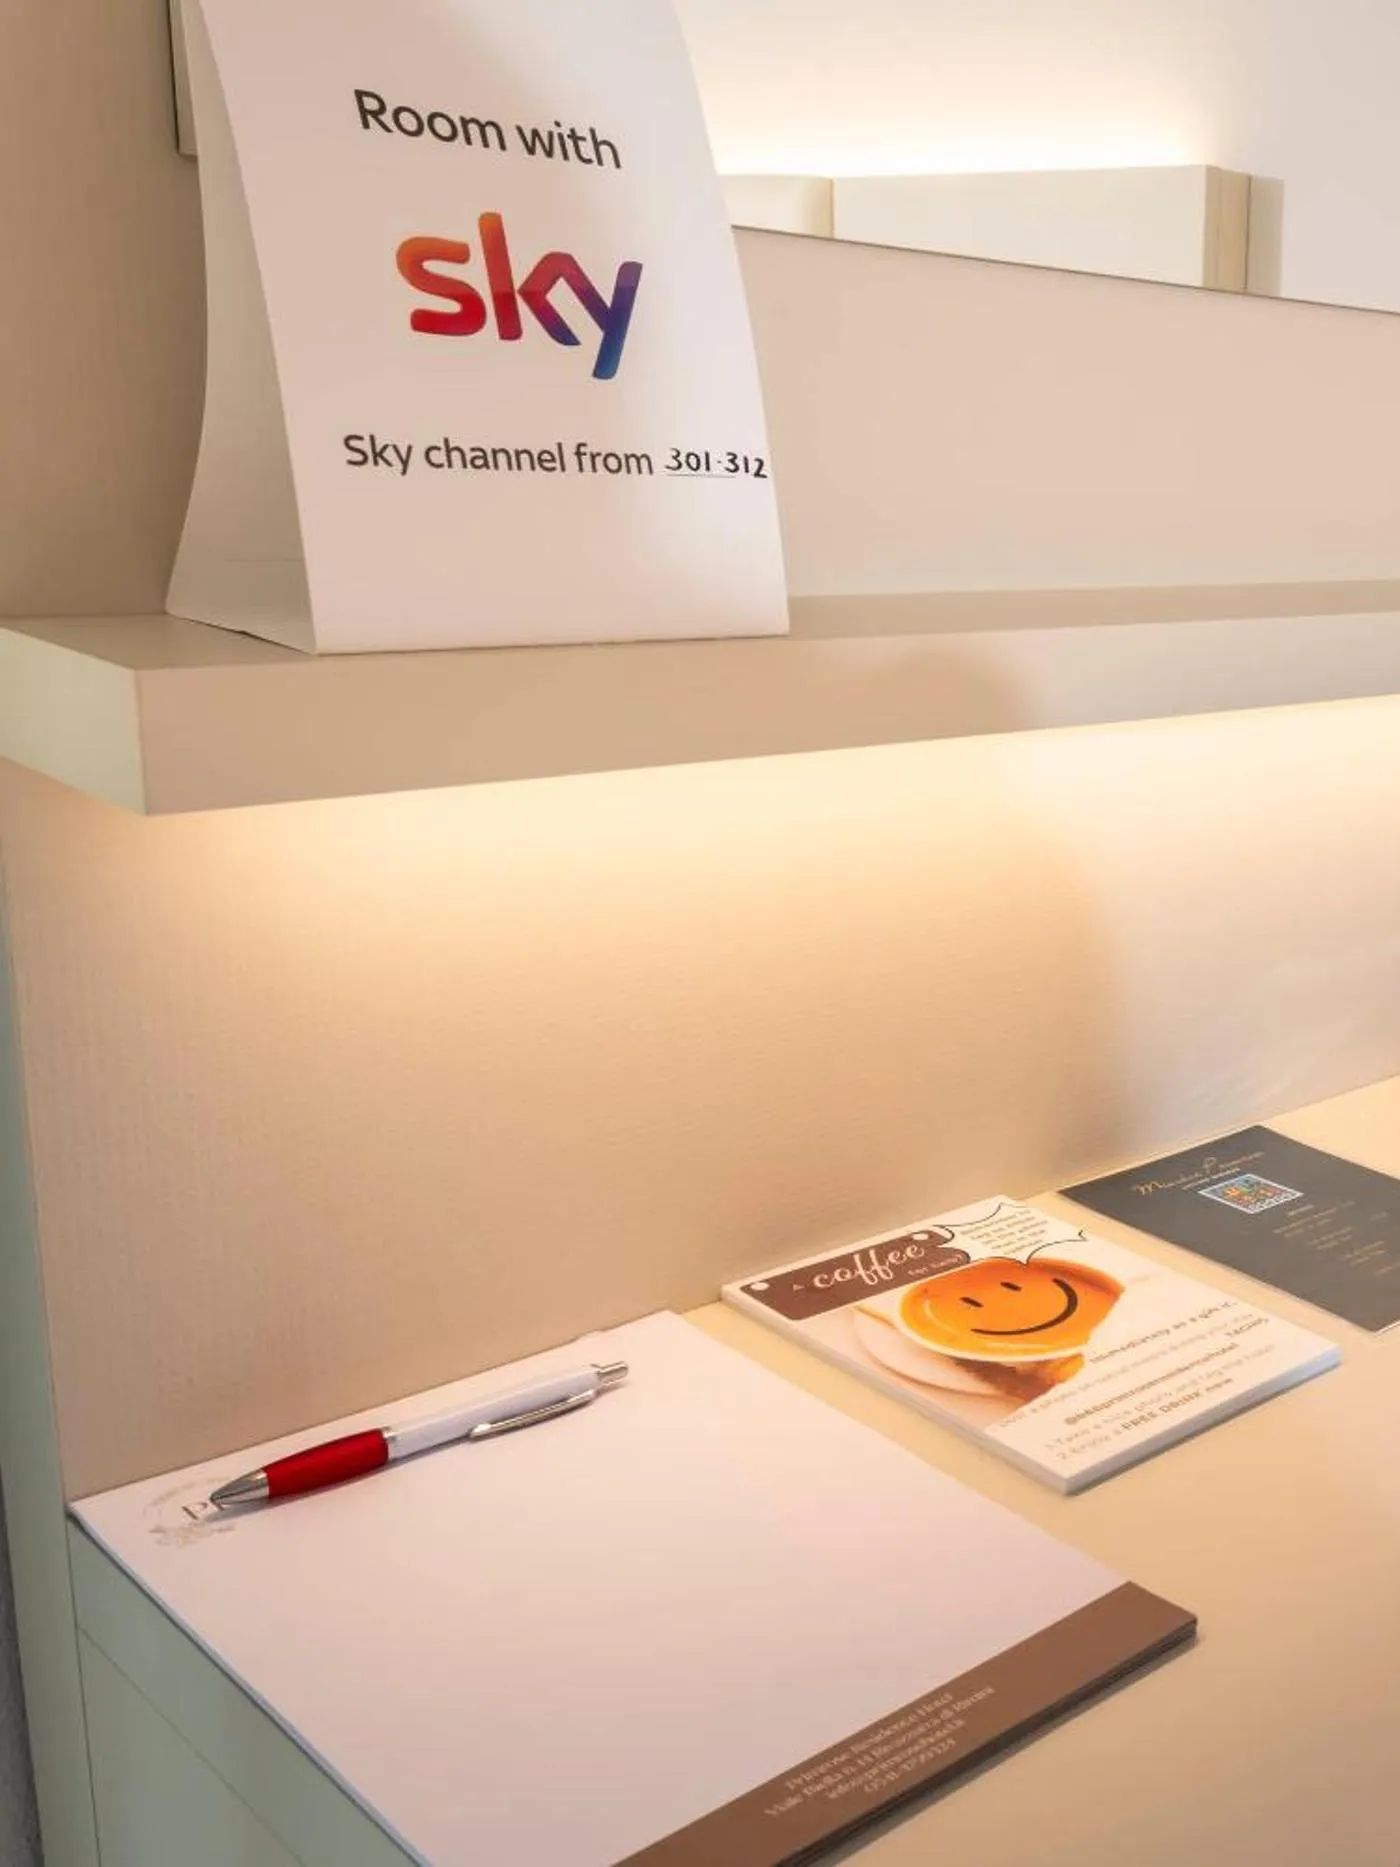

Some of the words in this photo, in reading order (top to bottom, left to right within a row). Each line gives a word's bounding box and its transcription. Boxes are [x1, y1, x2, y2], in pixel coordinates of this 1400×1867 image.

[353, 88, 507, 152] Room
[516, 120, 622, 169] with
[396, 211, 643, 380] sky
[343, 434, 413, 475] Sky
[424, 437, 567, 474] channel
[575, 442, 655, 475] from
[814, 1243, 925, 1288] coffee
